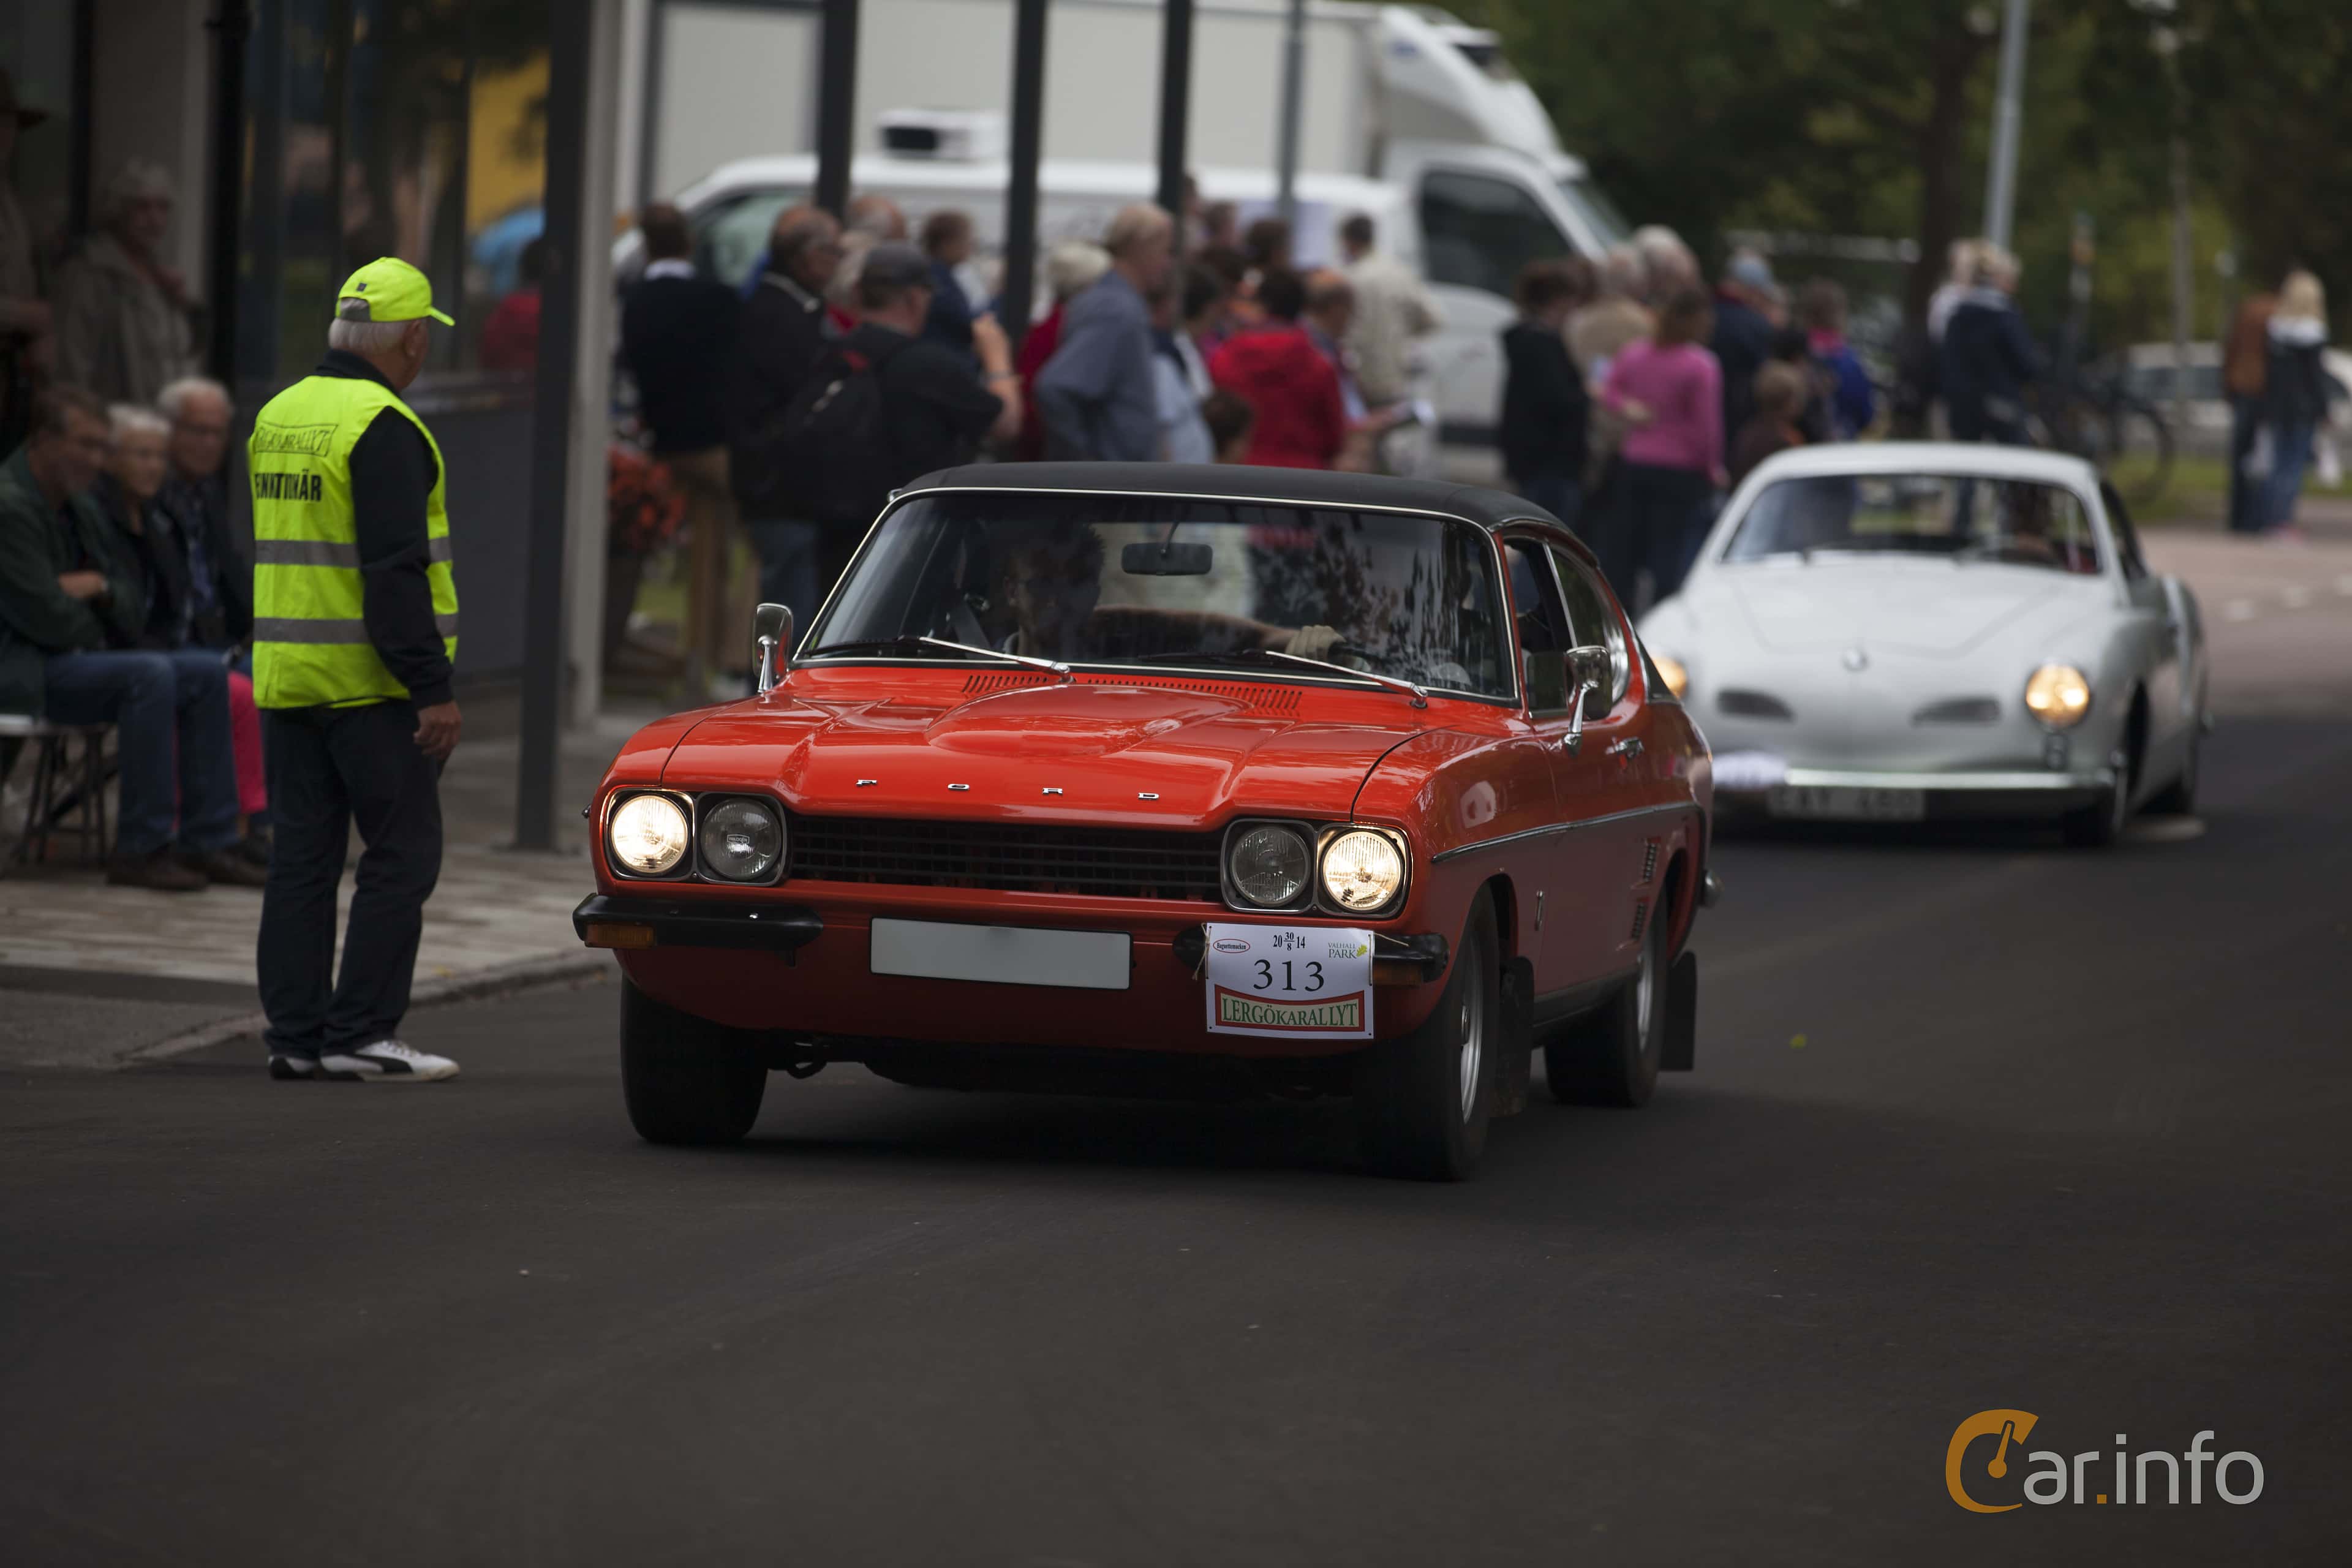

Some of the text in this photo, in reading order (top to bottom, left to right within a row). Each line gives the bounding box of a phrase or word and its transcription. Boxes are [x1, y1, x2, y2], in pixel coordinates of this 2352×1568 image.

[856, 779, 1159, 800] FORD
[1273, 935, 1283, 948] 20
[1285, 932, 1294, 940] 30
[1297, 936, 1305, 949] 14
[1329, 949, 1357, 959] PARK
[1253, 959, 1324, 992] 313
[1222, 997, 1358, 1027] LERGÖKARALLYT
